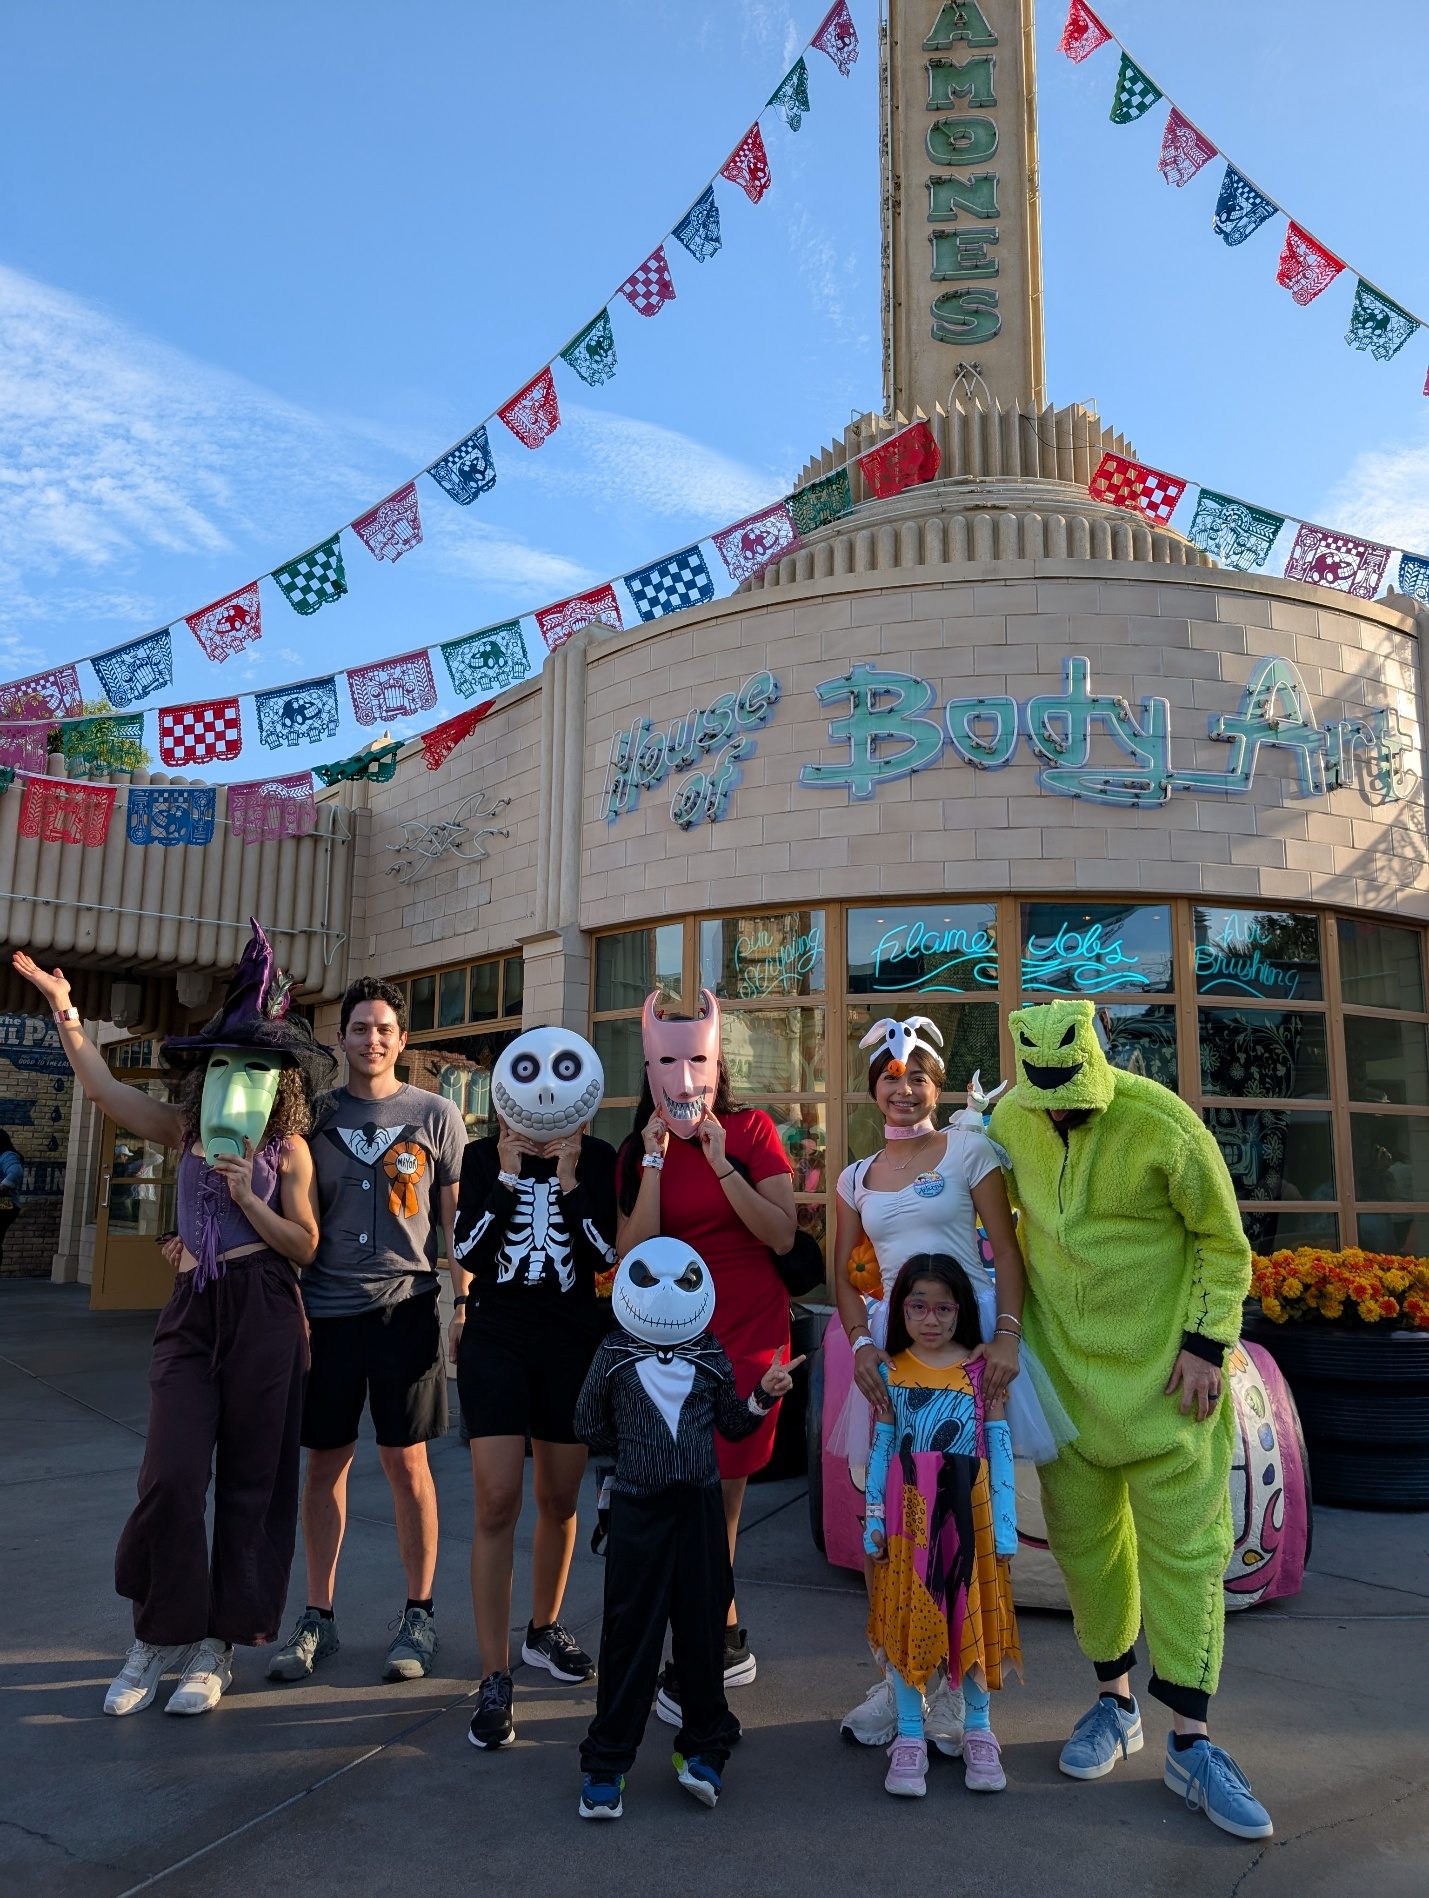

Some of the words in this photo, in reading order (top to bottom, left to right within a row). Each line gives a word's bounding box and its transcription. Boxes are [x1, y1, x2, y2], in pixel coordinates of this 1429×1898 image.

[600, 671, 781, 826] House
[800, 660, 1172, 809] Body
[1208, 655, 1419, 800] Art
[670, 736, 759, 833] of
[871, 921, 995, 977] Flame
[1028, 922, 1139, 963] Jobs
[1215, 913, 1272, 948] Air
[1194, 945, 1300, 1000] Brushing
[397, 1157, 417, 1170] MAYOR
